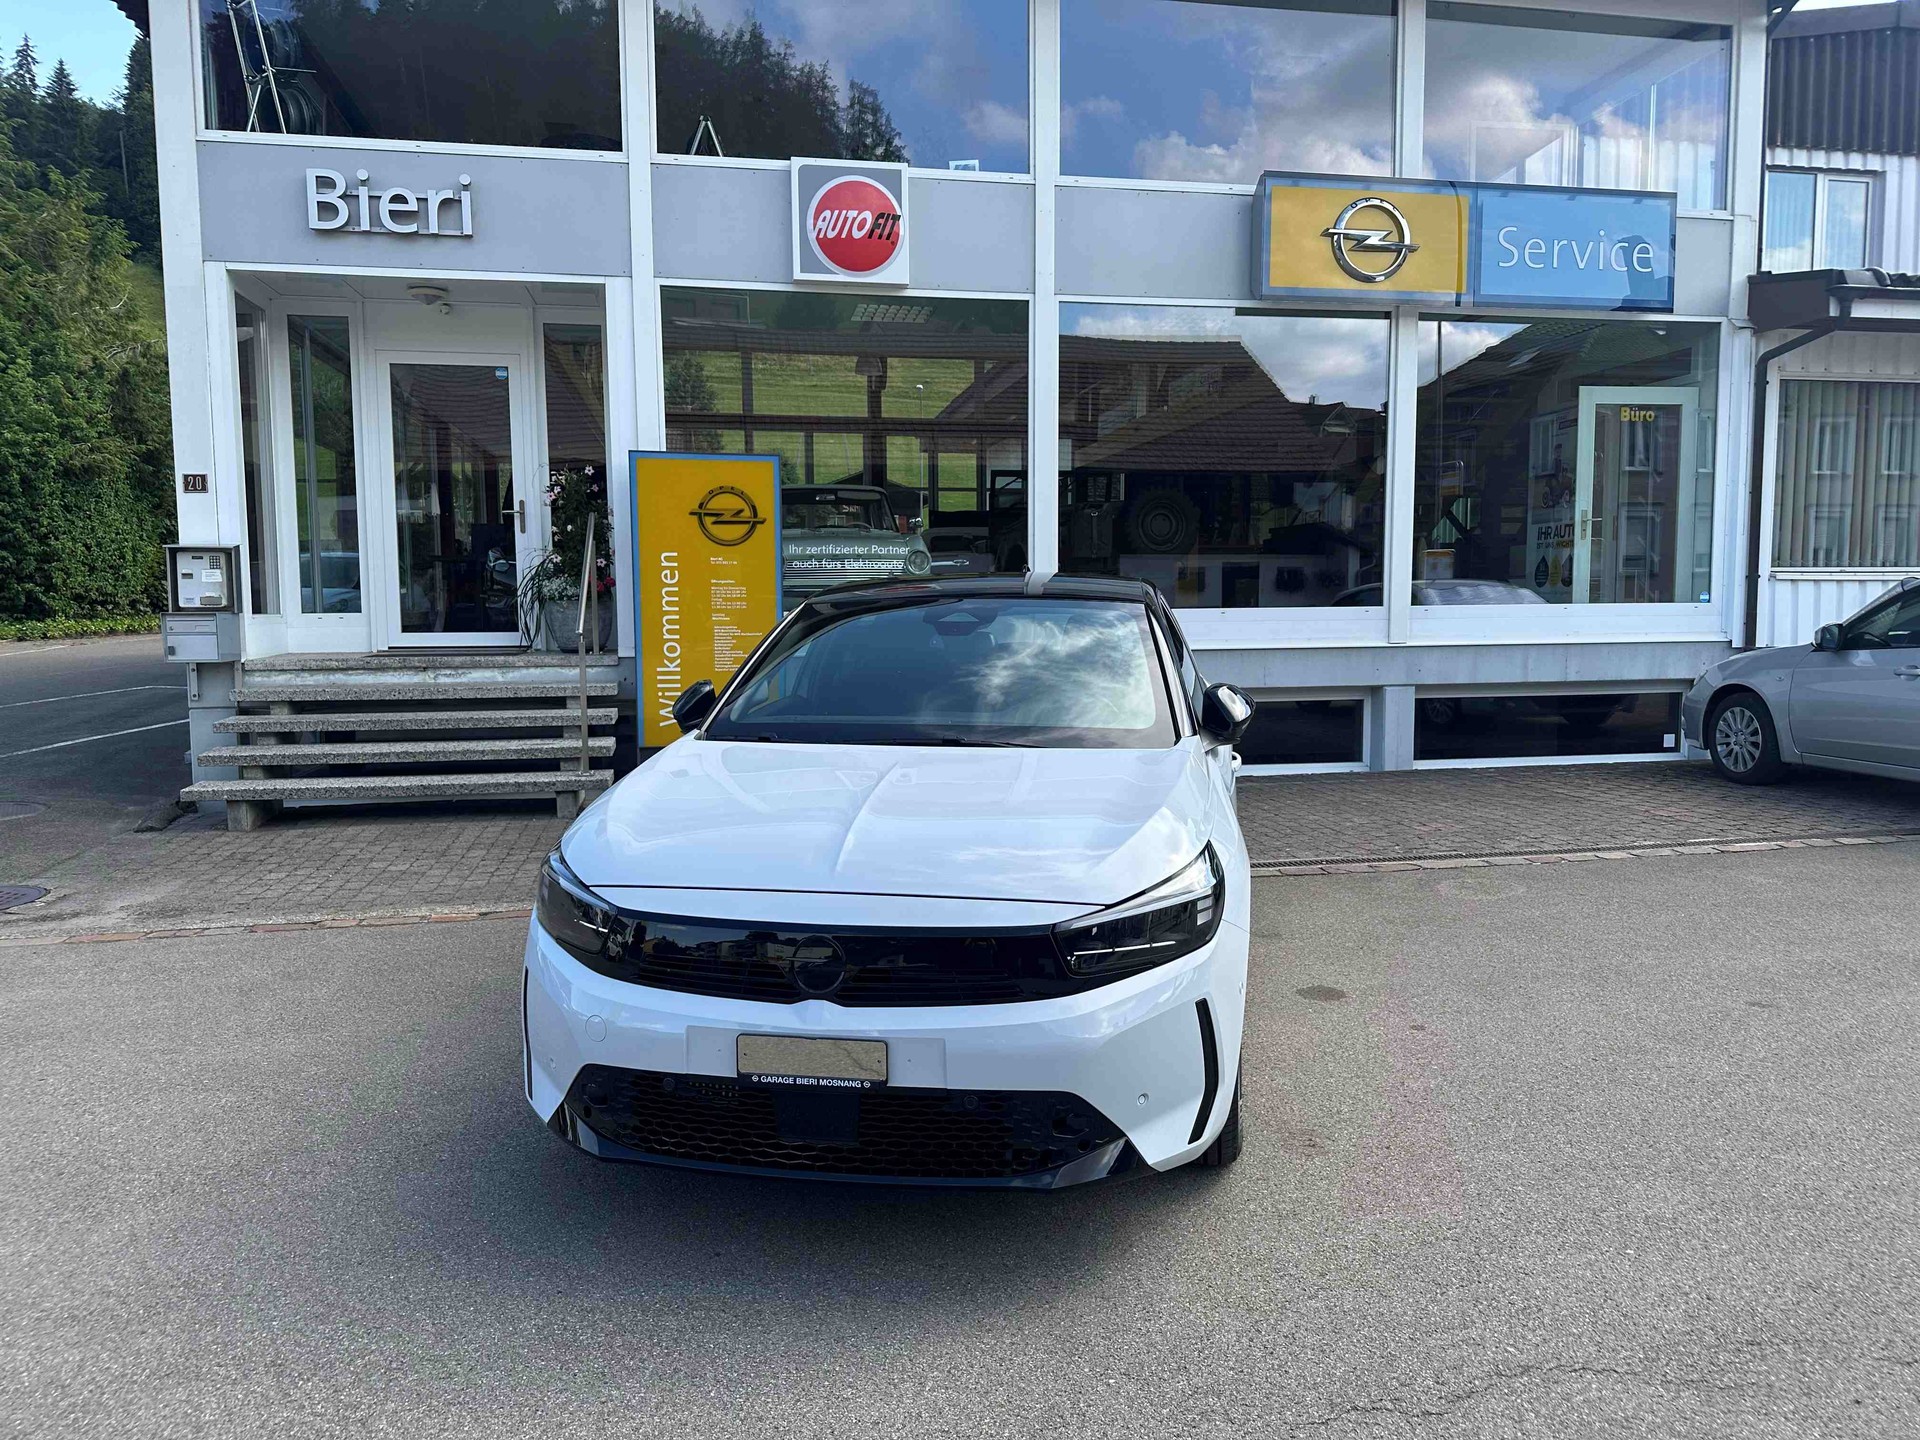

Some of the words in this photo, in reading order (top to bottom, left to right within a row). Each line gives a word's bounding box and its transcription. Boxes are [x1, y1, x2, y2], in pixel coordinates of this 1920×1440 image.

[305, 168, 473, 238] Bieri
[1498, 226, 1654, 273] Service
[1620, 406, 1655, 422] Büro
[187, 475, 202, 491] 20
[708, 485, 745, 495] OPEL
[1537, 526, 1552, 541] IHR
[788, 544, 803, 554] Ihr
[806, 544, 869, 554] zertifizierter
[871, 544, 910, 554] Partner
[793, 558, 819, 569] auch
[822, 557, 842, 569] fürs
[656, 551, 681, 727] Willkommen
[760, 1075, 795, 1085] GARAGE
[796, 1077, 818, 1086] BIERI
[819, 1079, 862, 1088] MOSNANG
